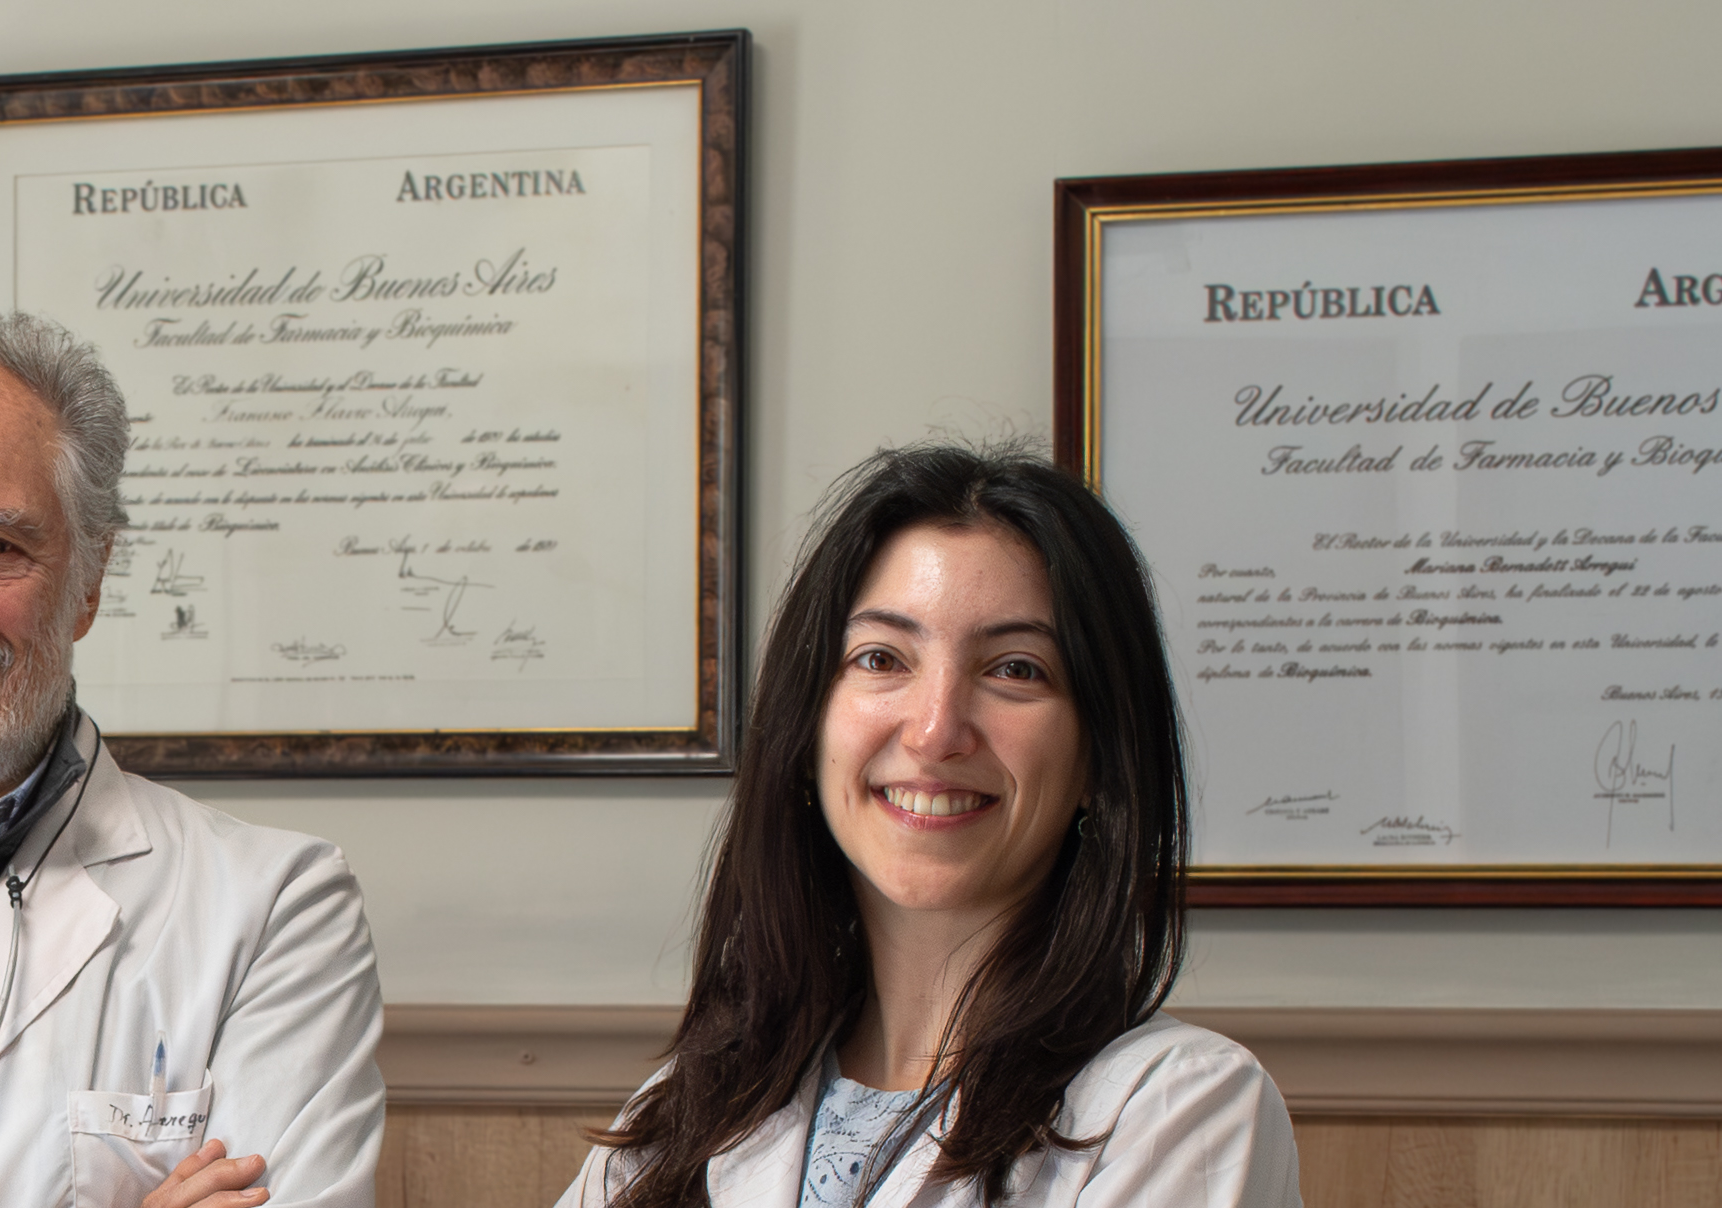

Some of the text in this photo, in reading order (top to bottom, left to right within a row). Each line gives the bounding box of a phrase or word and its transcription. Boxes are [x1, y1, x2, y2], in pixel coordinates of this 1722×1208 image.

[71, 168, 586, 215] REPÚBLICA ARGENTINA
[94, 246, 558, 310] Universidad de Buenos Aires
[1203, 281, 1441, 322] REPÚBLICA
[132, 307, 516, 350] Facultad de Farmacia y Bioquímica
[1233, 374, 1721, 427] Universidad de Buenos
[1261, 443, 1403, 476] Facultad
[1409, 444, 1443, 473] de
[1452, 440, 1598, 472] Farmacia
[1595, 448, 1625, 477] y
[1312, 532, 1336, 551] El
[1334, 532, 1392, 551] Rector
[1393, 532, 1413, 549] de
[1414, 531, 1433, 548] la
[1440, 529, 1538, 549] Universidad
[1532, 537, 1549, 552] y
[1551, 528, 1569, 546] la
[1572, 527, 1637, 546] Decana
[1638, 528, 1658, 545] de
[1661, 526, 1680, 544] la
[1197, 563, 1227, 579] Por
[1404, 556, 1477, 576] Mariana
[1480, 555, 1570, 574] Bernadett
[1569, 554, 1639, 577] Arregui
[1196, 587, 1256, 604] natural
[1254, 588, 1272, 603] de
[1276, 587, 1293, 603] la
[1298, 586, 1367, 602] Provincia
[1372, 586, 1391, 601] de
[1396, 584, 1451, 601] Buenos
[1504, 583, 1524, 599] ha
[1607, 581, 1631, 598] el
[1630, 584, 1652, 597] 22
[1653, 581, 1672, 597] de
[1385, 612, 1405, 627] de
[1295, 639, 1314, 653] de
[1257, 665, 1276, 679] de
[1600, 684, 1657, 701] Buenos
[109, 1103, 133, 1128] Dr.
